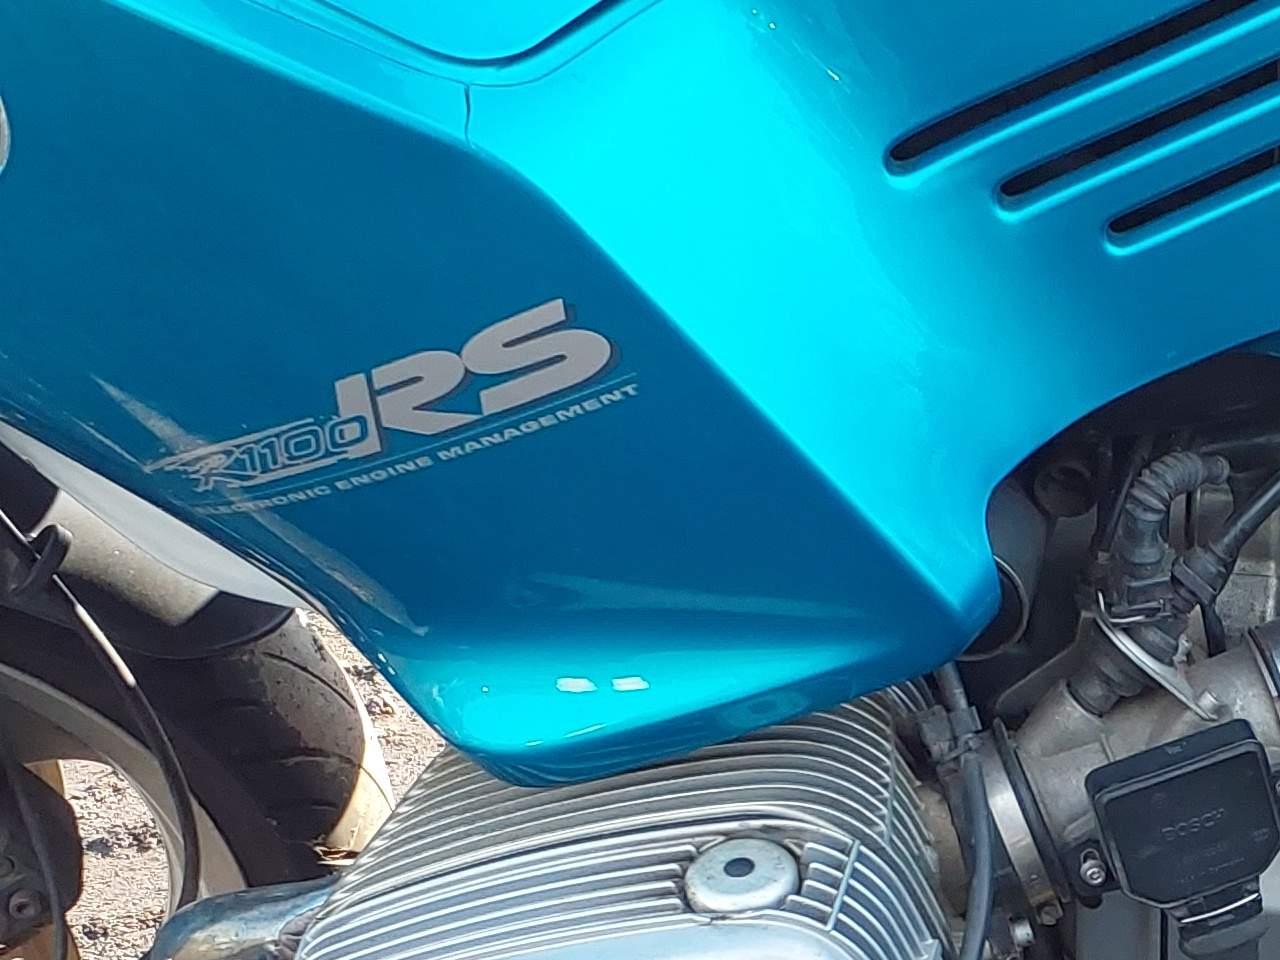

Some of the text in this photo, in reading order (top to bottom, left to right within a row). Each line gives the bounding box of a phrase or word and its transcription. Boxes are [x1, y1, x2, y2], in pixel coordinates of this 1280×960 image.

[170, 298, 615, 493] R1100 RS
[336, 456, 434, 490] ENGINE
[440, 383, 639, 461] MANAGEMENT
